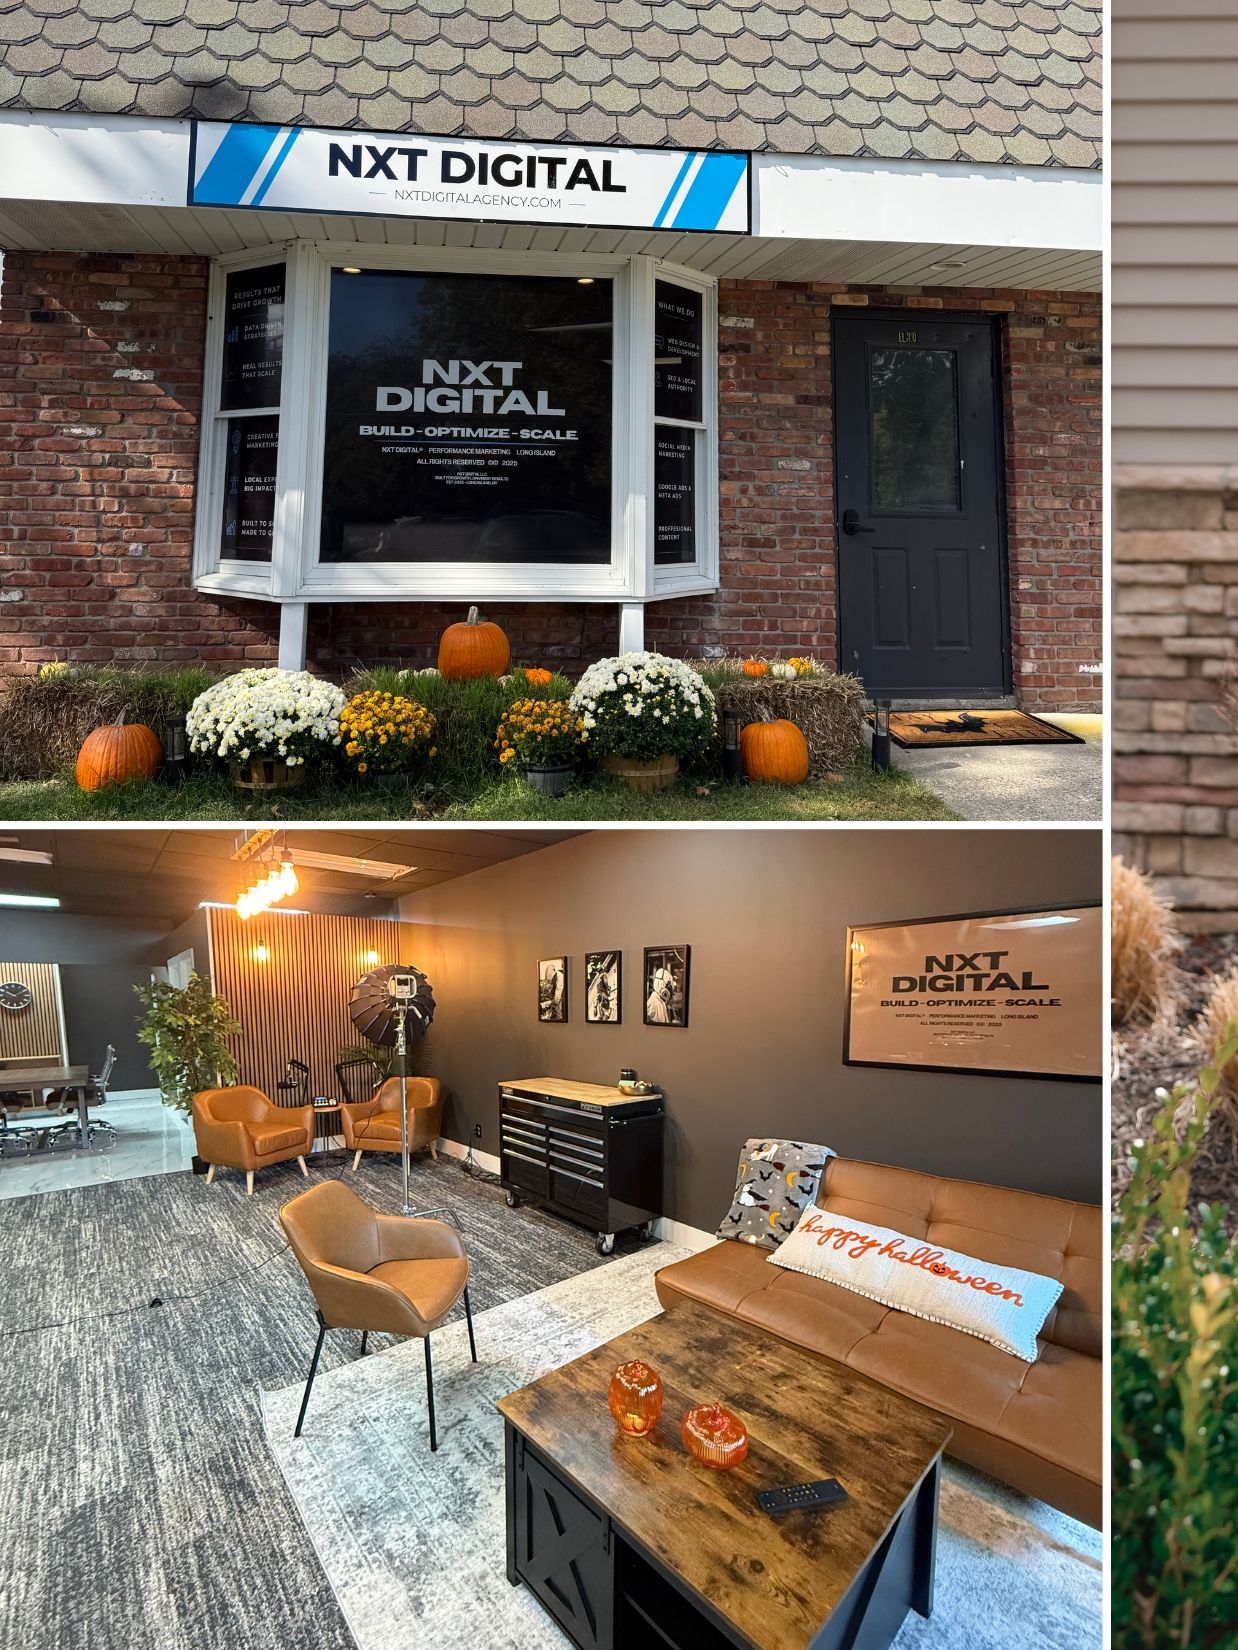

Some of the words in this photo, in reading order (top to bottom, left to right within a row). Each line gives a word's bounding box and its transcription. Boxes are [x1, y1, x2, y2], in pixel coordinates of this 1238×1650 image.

[328, 142, 428, 182] NXT
[440, 150, 626, 193] DIGITAL
[394, 189, 562, 209] NXTDIGITALAGENCY.COM
[234, 289, 262, 300] RESULTS
[263, 286, 281, 295] THAT
[232, 301, 252, 310] DRIVE
[253, 296, 282, 307] GROWTH
[659, 302, 674, 311] WHAT
[676, 307, 685, 315] WE
[687, 309, 695, 317] DO
[261, 321, 282, 330] DRIVEN
[422, 359, 522, 387] NXT
[668, 384, 693, 393] AUTHORITY
[376, 386, 566, 417] DIGITAL
[359, 425, 415, 436] BUILD
[425, 427, 510, 439] OPTIMIZE
[519, 429, 579, 440] SCALE
[659, 451, 685, 459] MARKETING
[925, 951, 1008, 973] NXT
[892, 972, 1049, 993] DIGITAL
[1005, 998, 1062, 1007] SCALE
[798, 1215, 882, 1259] happy
[878, 1239, 1024, 1308] halloween
